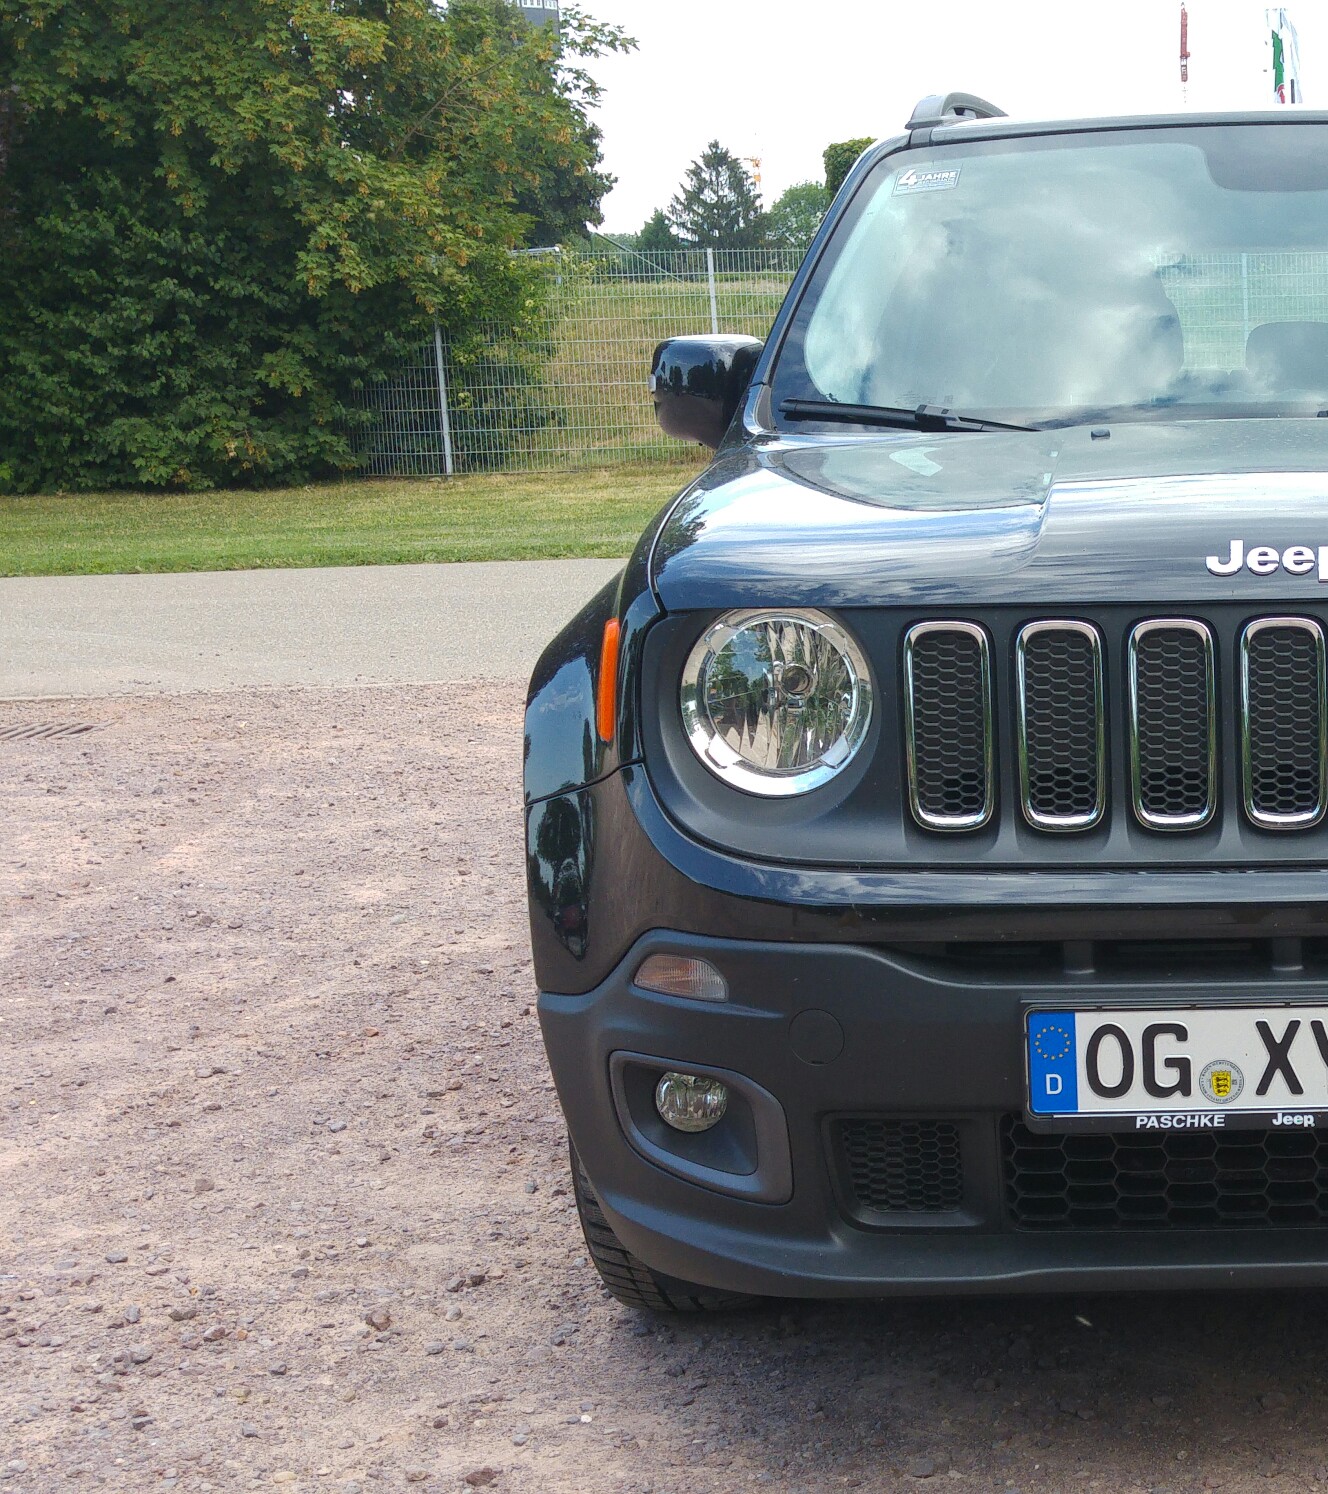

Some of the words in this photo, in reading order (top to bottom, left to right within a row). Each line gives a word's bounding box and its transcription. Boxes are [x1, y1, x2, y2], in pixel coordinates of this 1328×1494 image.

[898, 169, 918, 186] 4
[919, 171, 957, 182] JAHRE
[1086, 1022, 1192, 1099] OG
[1045, 1073, 1063, 1095] D
[1135, 1114, 1226, 1129] PASCHKE
[1271, 1112, 1315, 1128] Jeep
